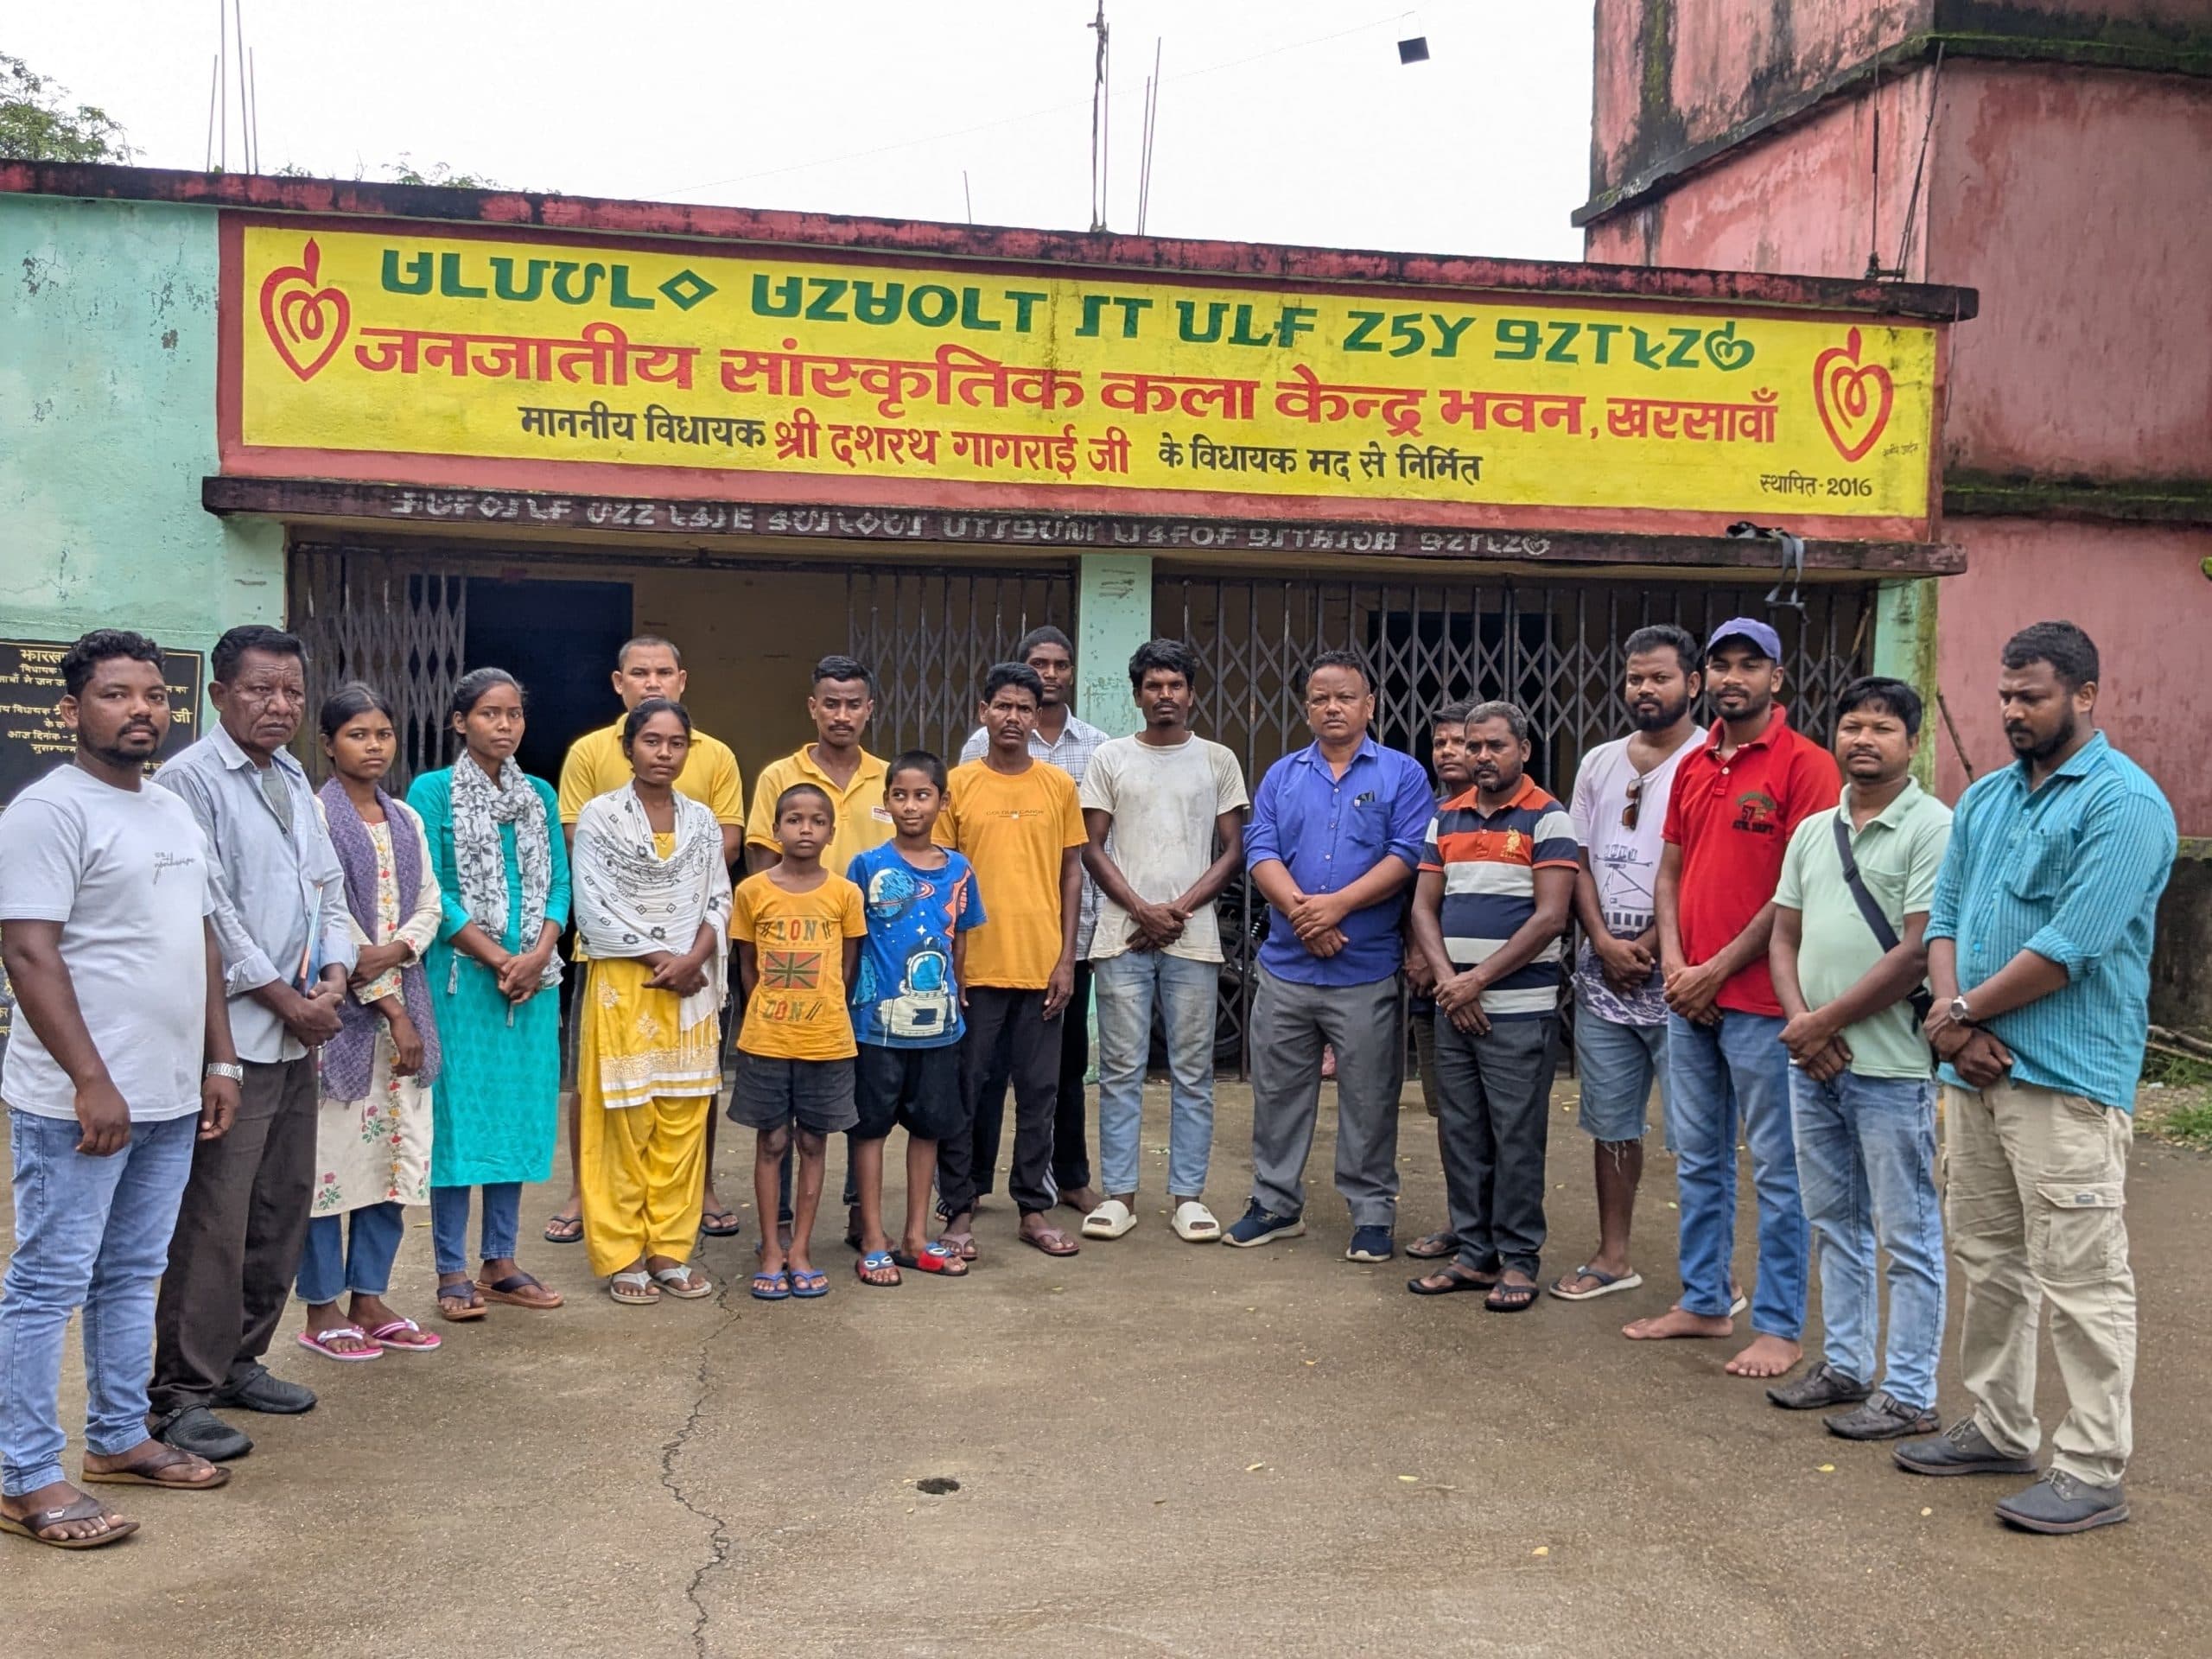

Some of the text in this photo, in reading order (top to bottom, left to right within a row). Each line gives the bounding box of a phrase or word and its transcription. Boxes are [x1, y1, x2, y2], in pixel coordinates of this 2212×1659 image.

[354, 322, 701, 390] जनजातीय
[721, 338, 1084, 418] सांस्कृतिक
[1100, 371, 1260, 420] कला
[1274, 364, 1427, 438] केन्द्र
[1607, 386, 1777, 443] खरसावाँ
[518, 400, 1484, 486] माननीय विधायक श्री दशरथ गागराई जी के विधायक मद से निर्मित
[171, 707, 193, 724] जी
